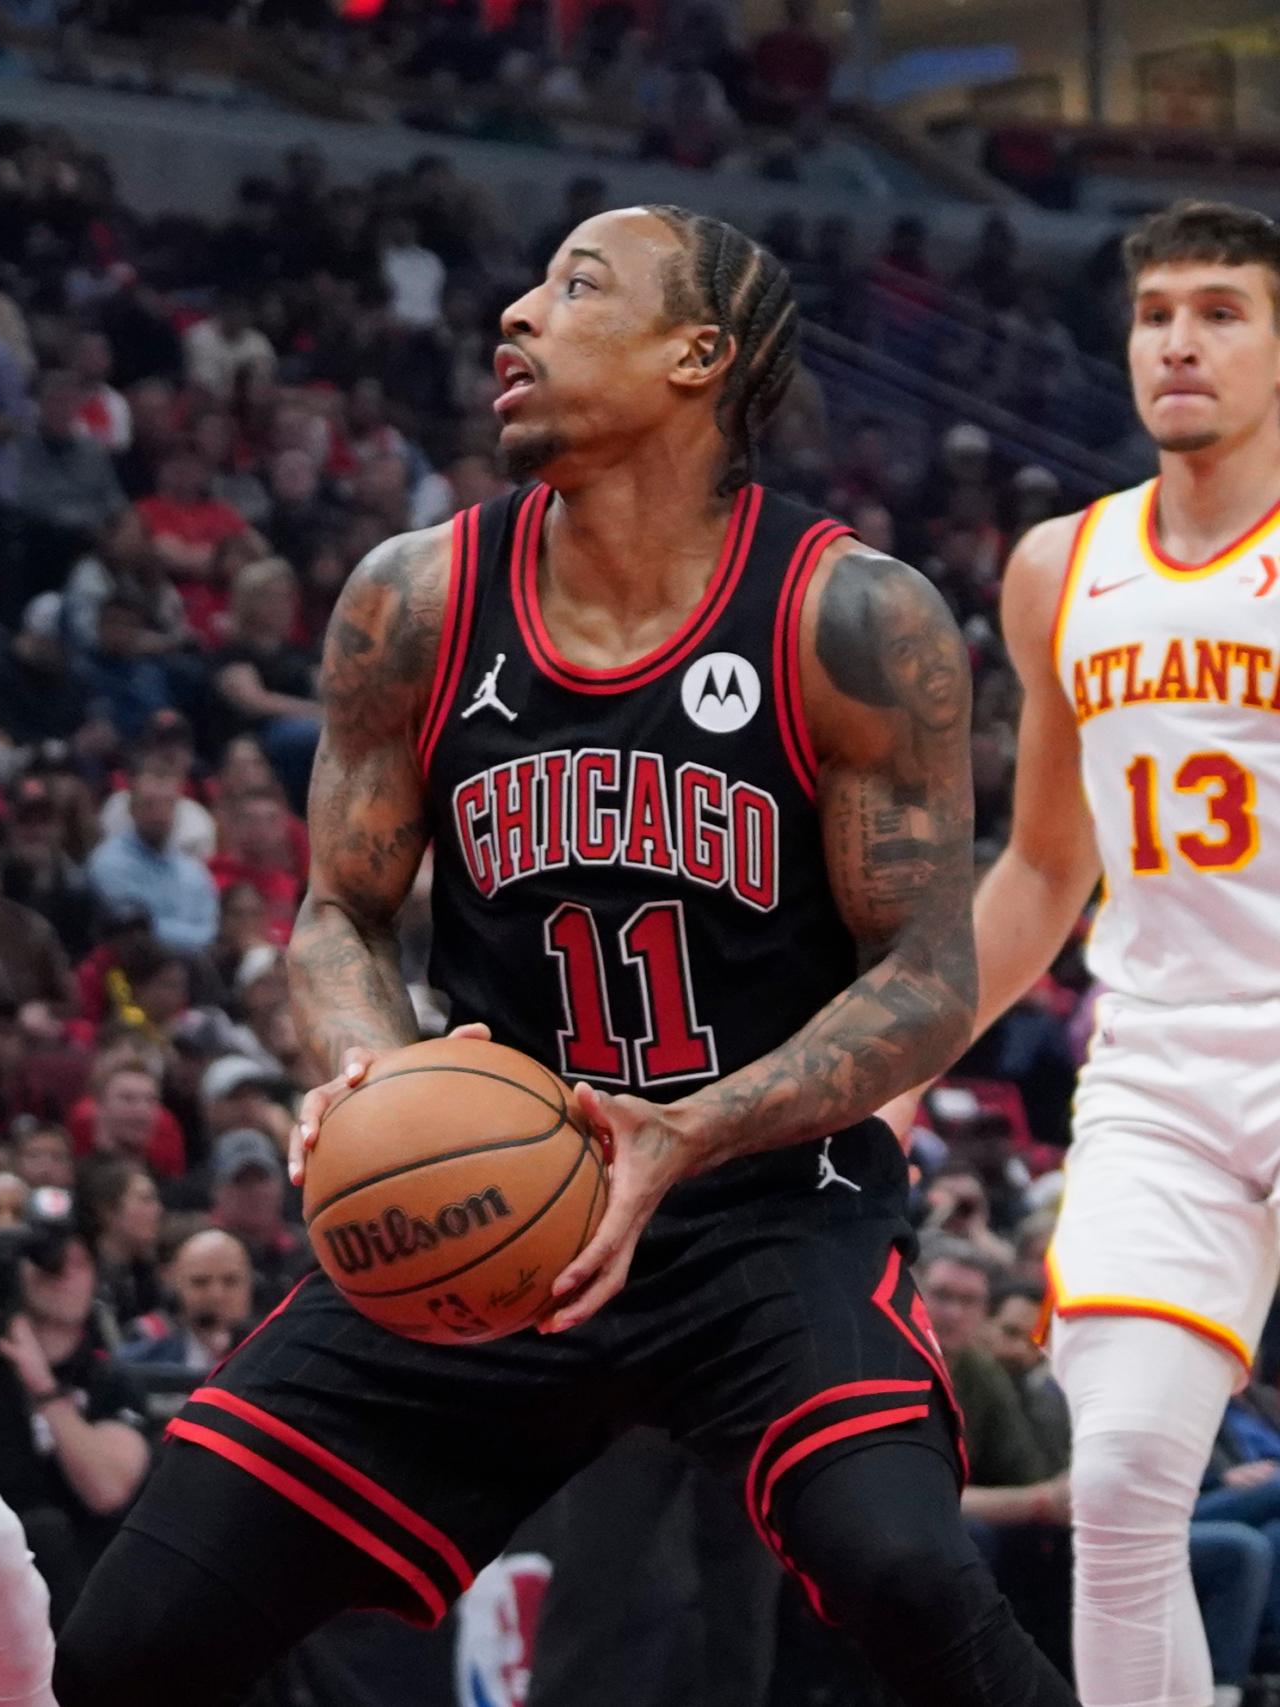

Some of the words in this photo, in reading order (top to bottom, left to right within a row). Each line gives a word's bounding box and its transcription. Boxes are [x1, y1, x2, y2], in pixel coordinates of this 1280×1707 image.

[1073, 637, 1280, 726] ATLANT
[453, 748, 778, 912] CHICAGO
[1126, 753, 1260, 875] 13
[544, 901, 719, 1086] 11
[324, 1185, 512, 1274] Wilson
